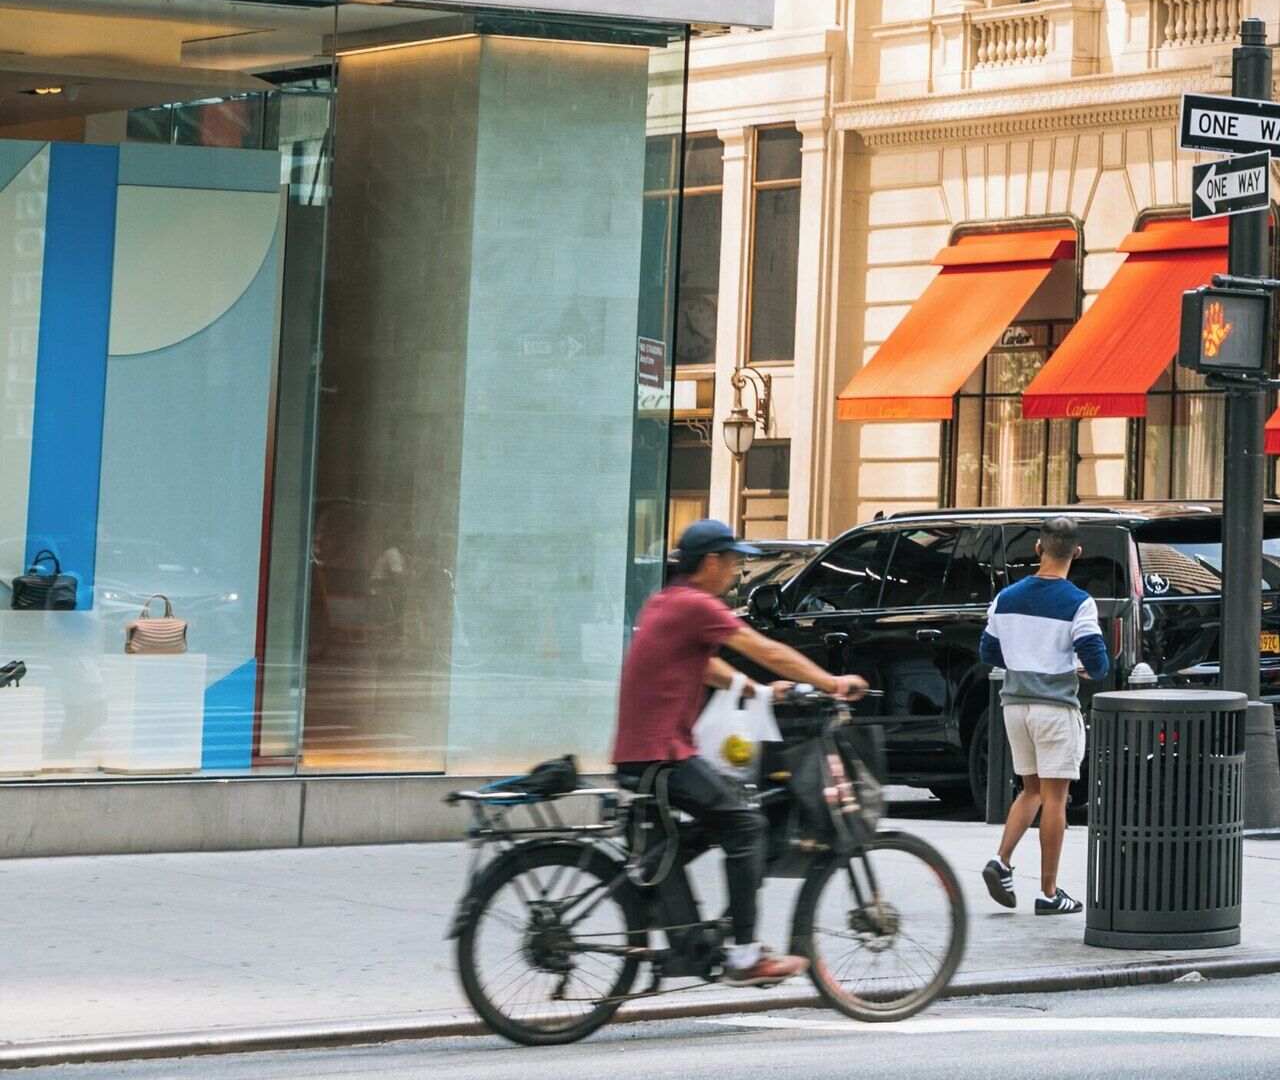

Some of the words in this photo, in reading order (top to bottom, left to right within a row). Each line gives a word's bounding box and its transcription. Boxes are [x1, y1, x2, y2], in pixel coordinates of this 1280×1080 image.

[1198, 113, 1239, 137] ONE
[1206, 177, 1227, 199] ONE
[1238, 170, 1261, 193] WAY
[1001, 328, 1032, 344] Cartier
[1066, 396, 1101, 416] Cartier
